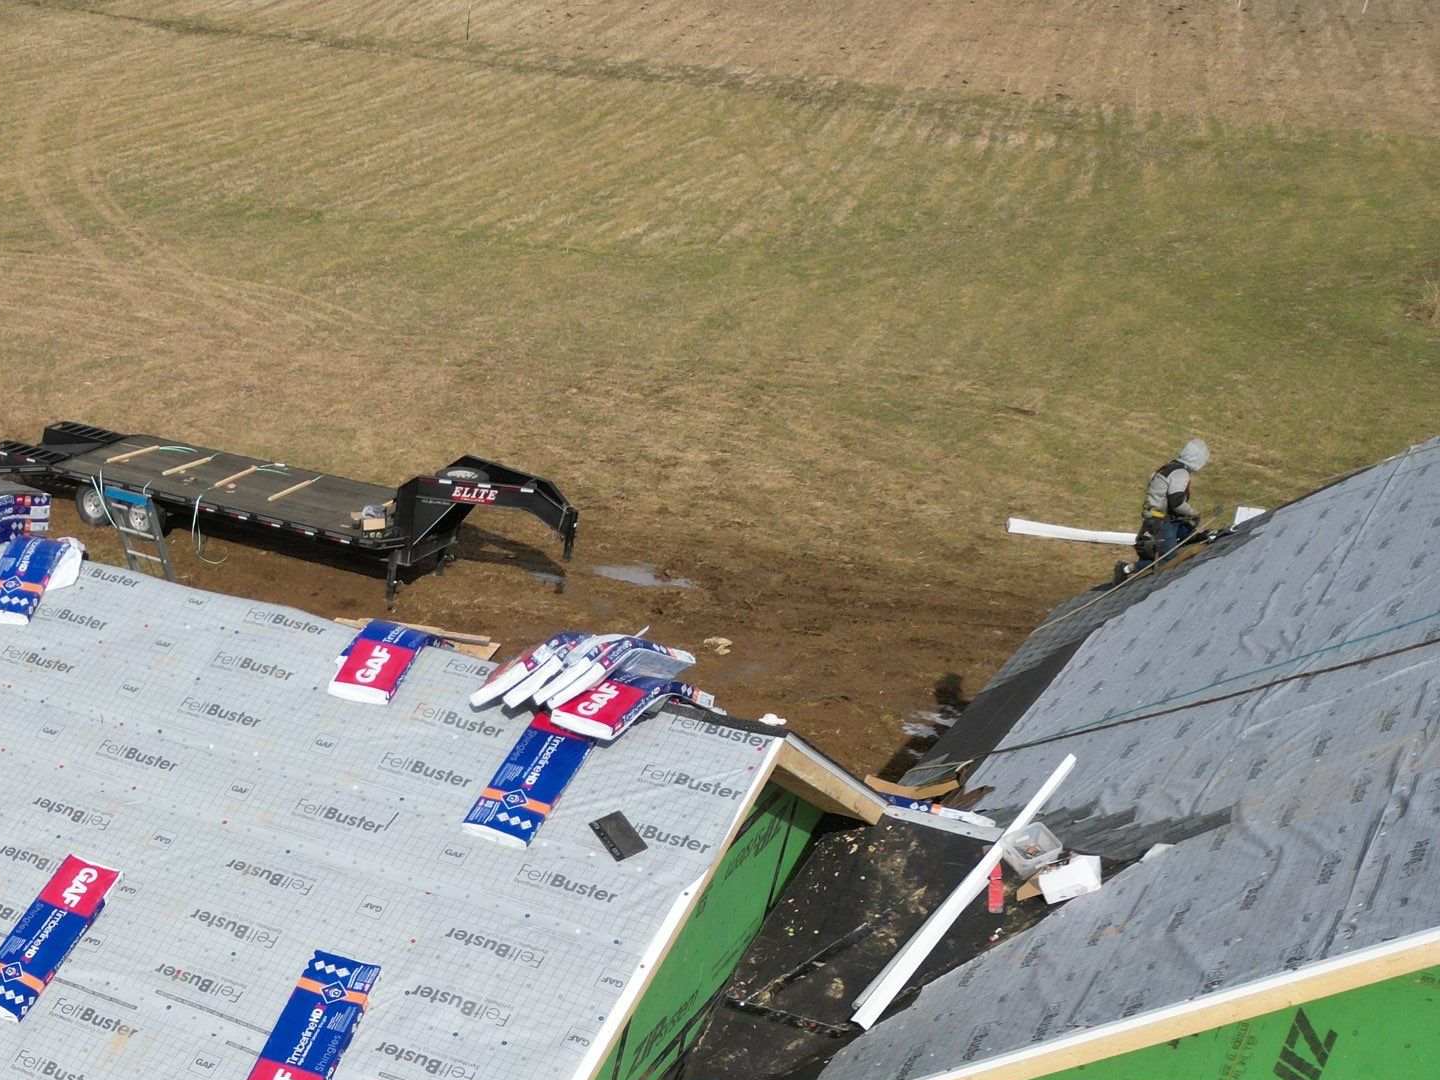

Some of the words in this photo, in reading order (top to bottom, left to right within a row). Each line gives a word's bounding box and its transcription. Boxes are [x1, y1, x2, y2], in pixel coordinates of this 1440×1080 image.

[452, 487, 498, 500] ELITE
[188, 598, 205, 606] GAF
[246, 607, 326, 636] FeltBuster
[3, 646, 75, 675] FeltBuster
[356, 644, 392, 683] GAF
[578, 683, 620, 716] GAF
[415, 703, 504, 738] FeltBuster
[524, 735, 564, 785] TimberlineHD
[641, 764, 741, 801] FeltBuster
[33, 797, 110, 830] FeltBuster
[295, 798, 384, 833] FeltBuster
[62, 867, 98, 909] GAF
[518, 865, 618, 903] FeltBuster
[24, 909, 68, 960] TimberlineHD
[190, 908, 279, 948] FeltBuster
[601, 977, 624, 987] GAF
[52, 998, 138, 1038] FeltBuster
[286, 1005, 322, 1065] TimberlineHD
[314, 1034, 342, 1073] Shingles
